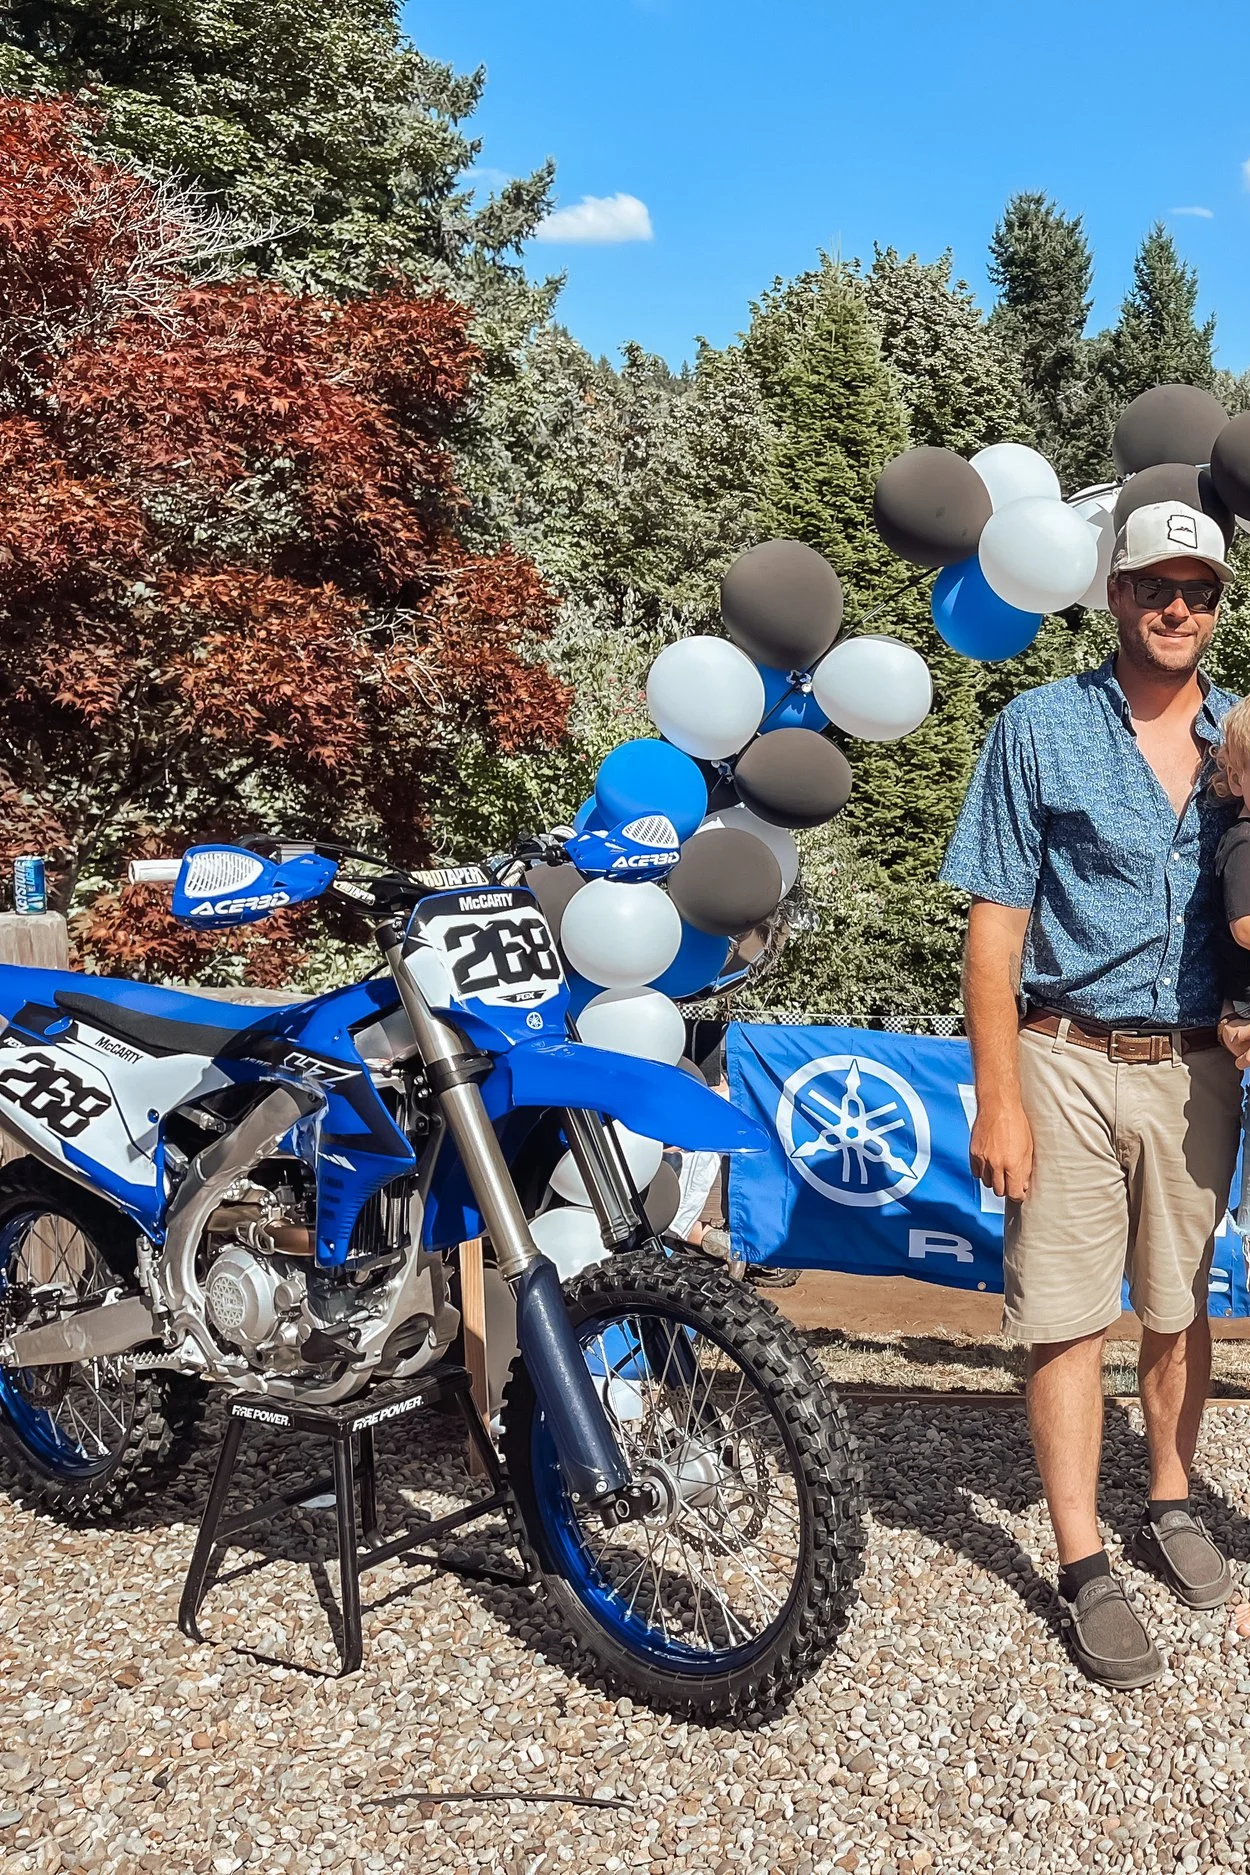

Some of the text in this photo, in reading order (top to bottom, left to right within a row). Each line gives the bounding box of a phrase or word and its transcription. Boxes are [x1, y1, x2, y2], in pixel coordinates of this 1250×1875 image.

[458, 892, 514, 912] McCARTY
[442, 917, 562, 995] 268
[94, 1035, 144, 1065] McCARTY
[0, 1051, 112, 1138] 268
